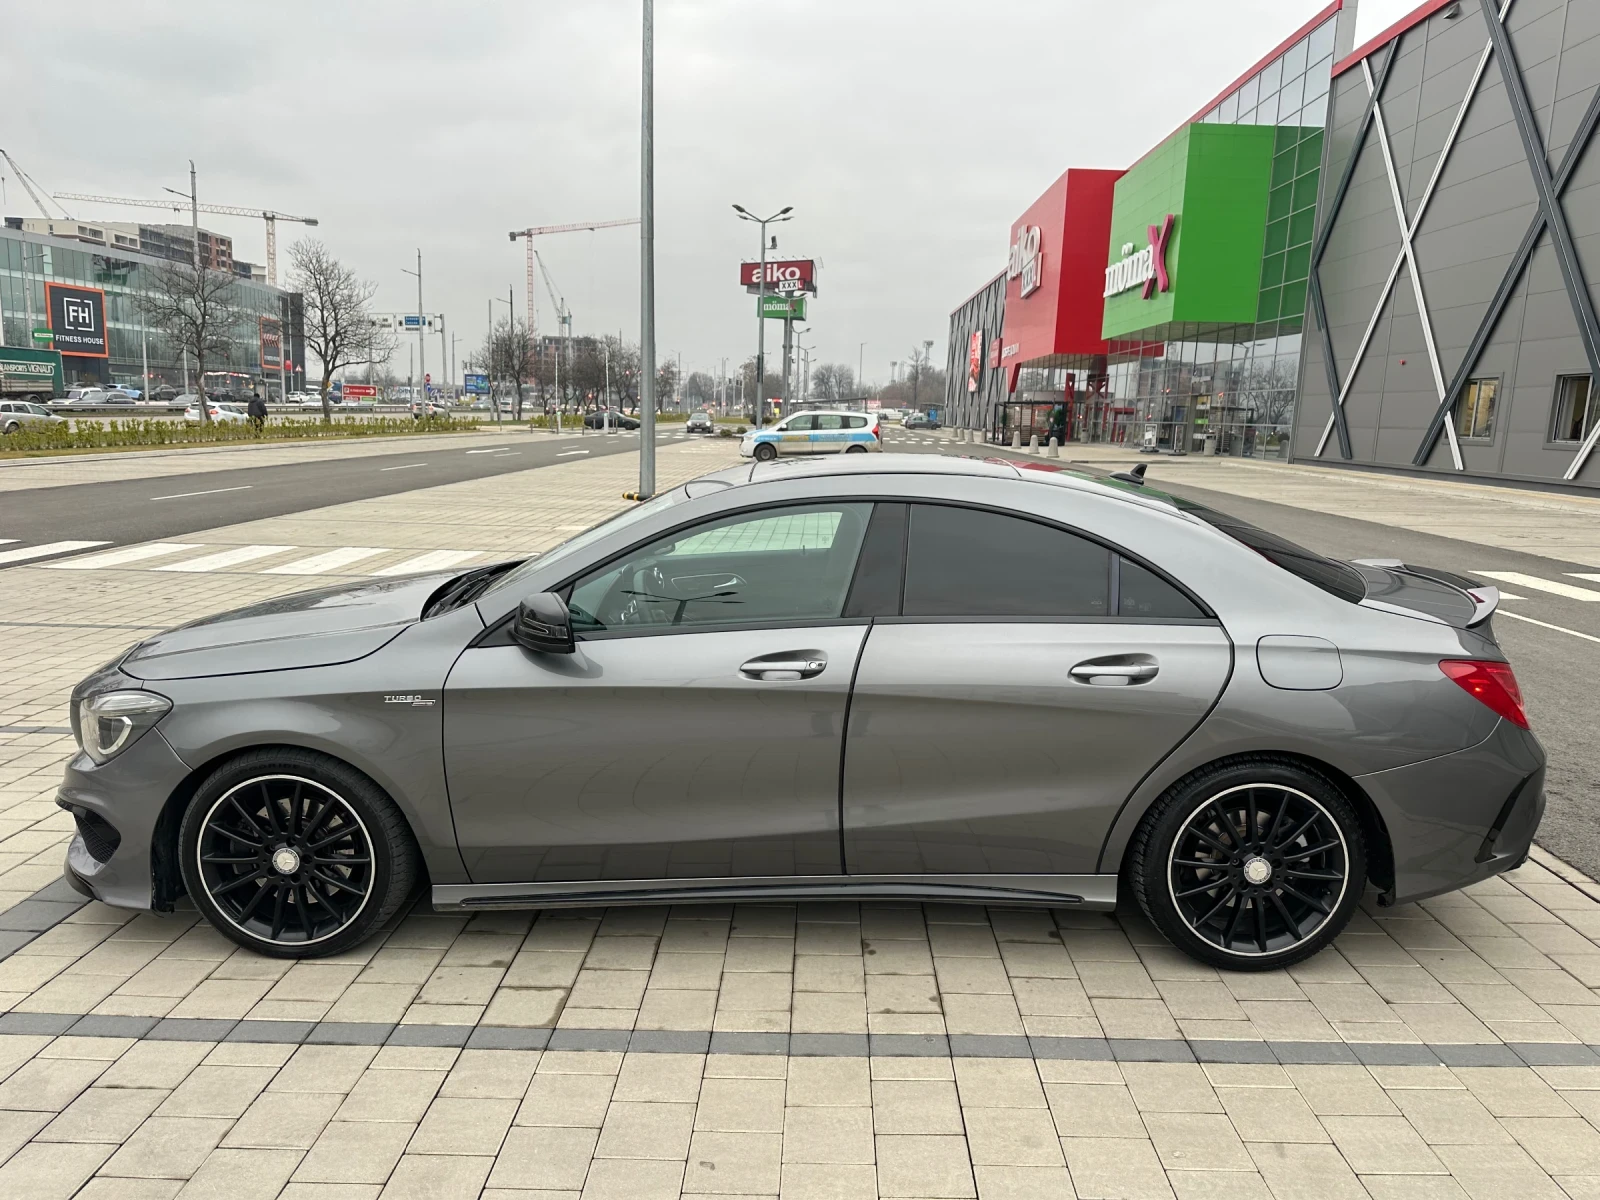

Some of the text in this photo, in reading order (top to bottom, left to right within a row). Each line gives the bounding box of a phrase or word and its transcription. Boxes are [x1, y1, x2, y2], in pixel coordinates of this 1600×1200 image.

[751, 264, 801, 283] aiko
[69, 305, 90, 324] FH
[55, 334, 82, 343] FITNESS
[83, 337, 104, 345] HOUSE
[383, 694, 422, 702] TURBO
